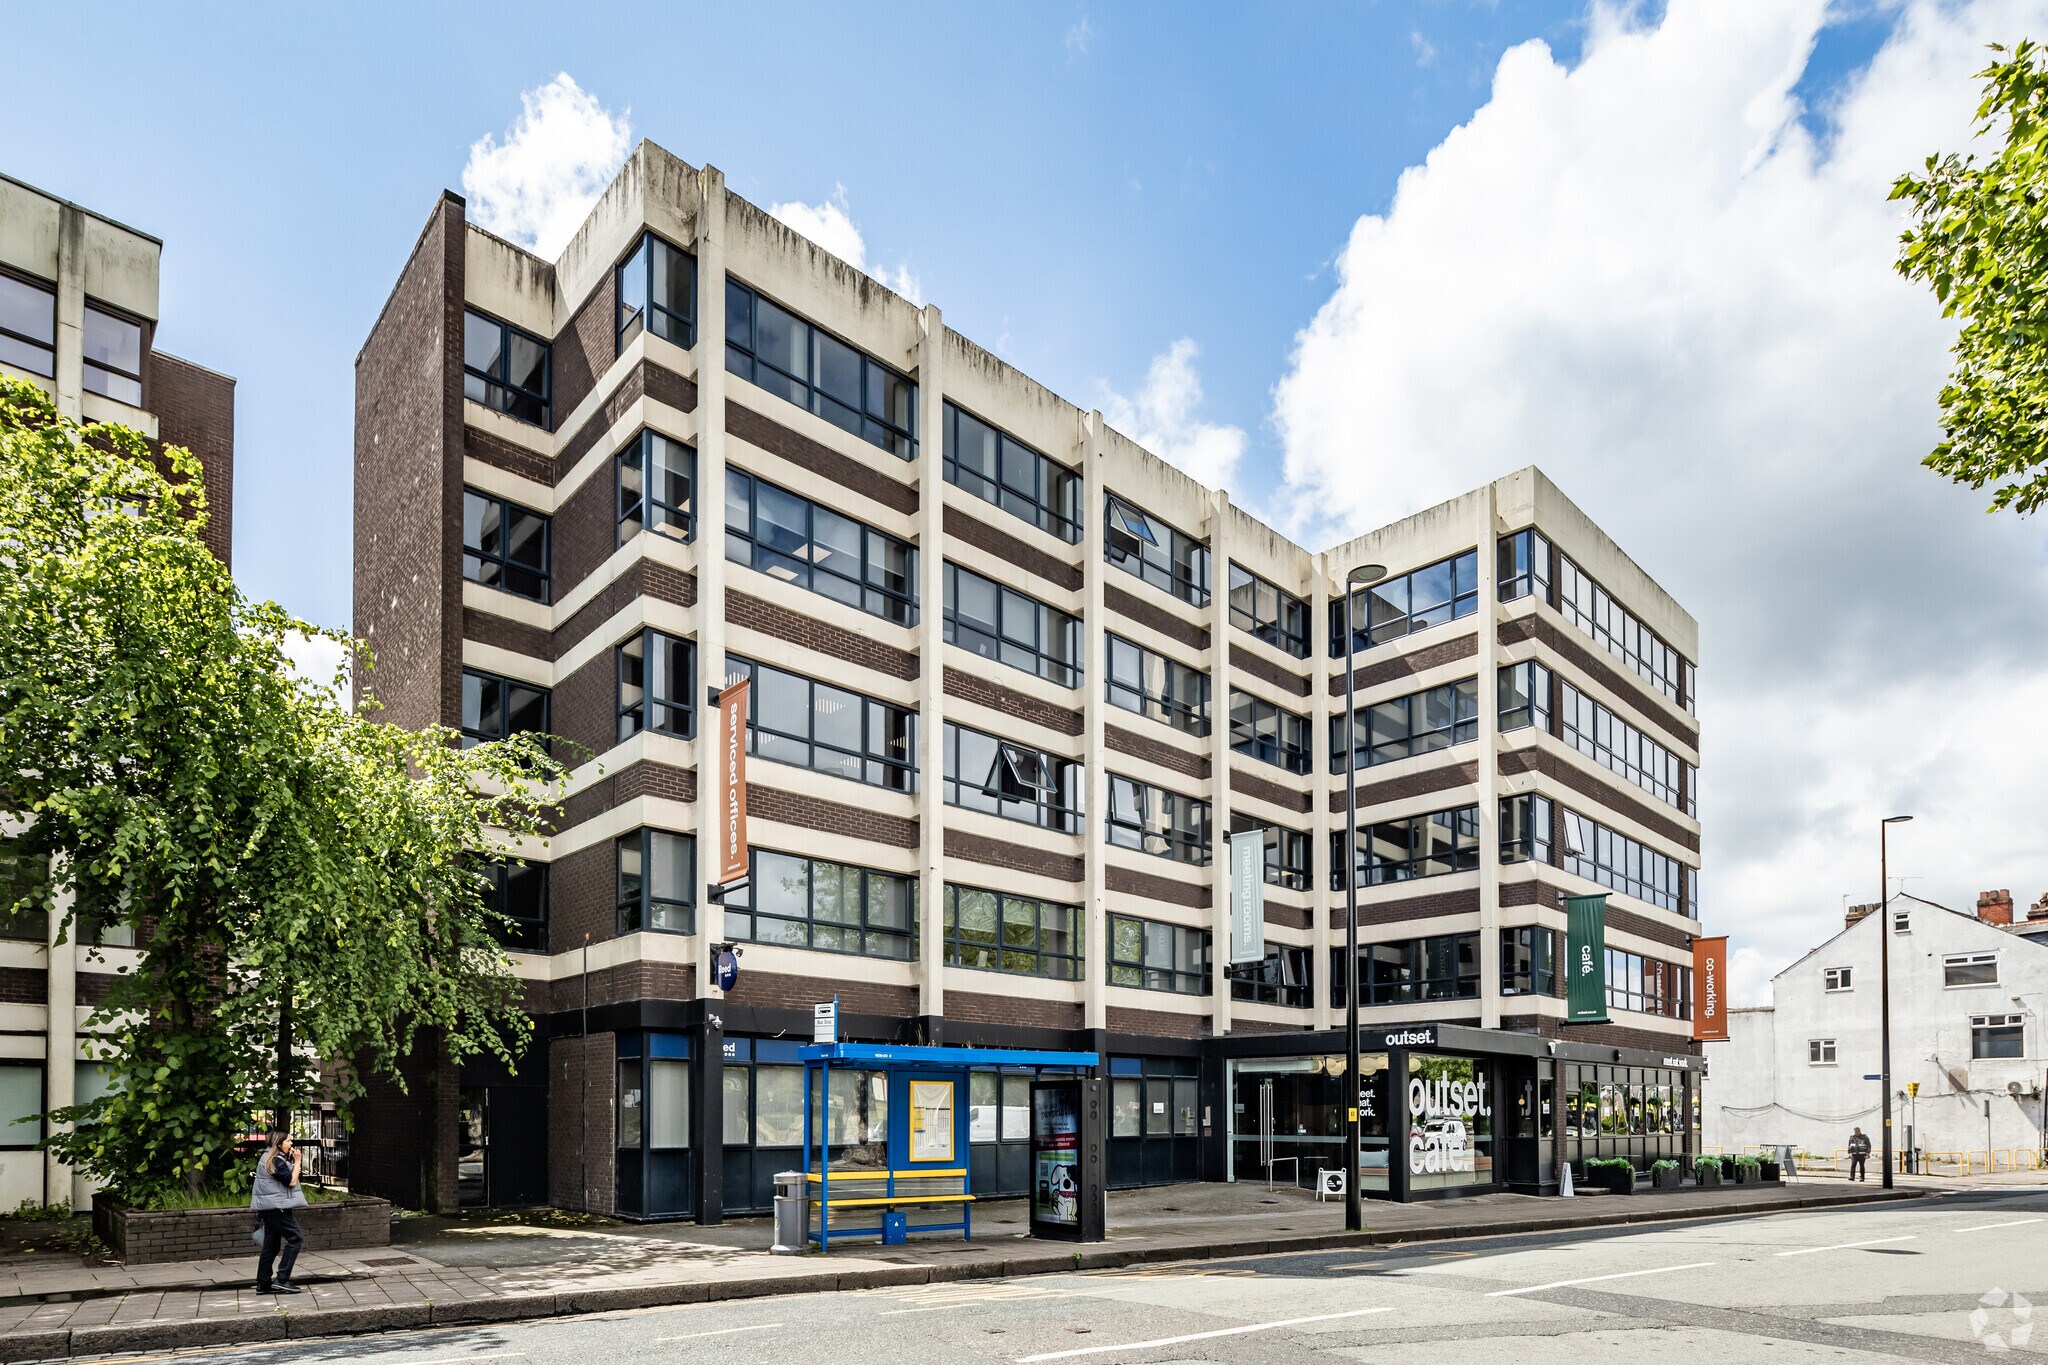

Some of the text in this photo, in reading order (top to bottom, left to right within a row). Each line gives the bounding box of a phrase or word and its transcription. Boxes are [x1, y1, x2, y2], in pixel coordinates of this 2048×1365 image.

[729, 702, 738, 786] serviced
[729, 788, 739, 860] offices.
[1242, 846, 1254, 899] meeting
[1243, 901, 1252, 946] rooms.
[1581, 945, 1594, 977] café.
[1704, 957, 1717, 1019] co-working.
[722, 1042, 736, 1052] ed
[1385, 1029, 1435, 1046] outset.
[1359, 1088, 1376, 1098] eet.
[1359, 1107, 1376, 1117] ork.
[1408, 1070, 1492, 1117] outset.
